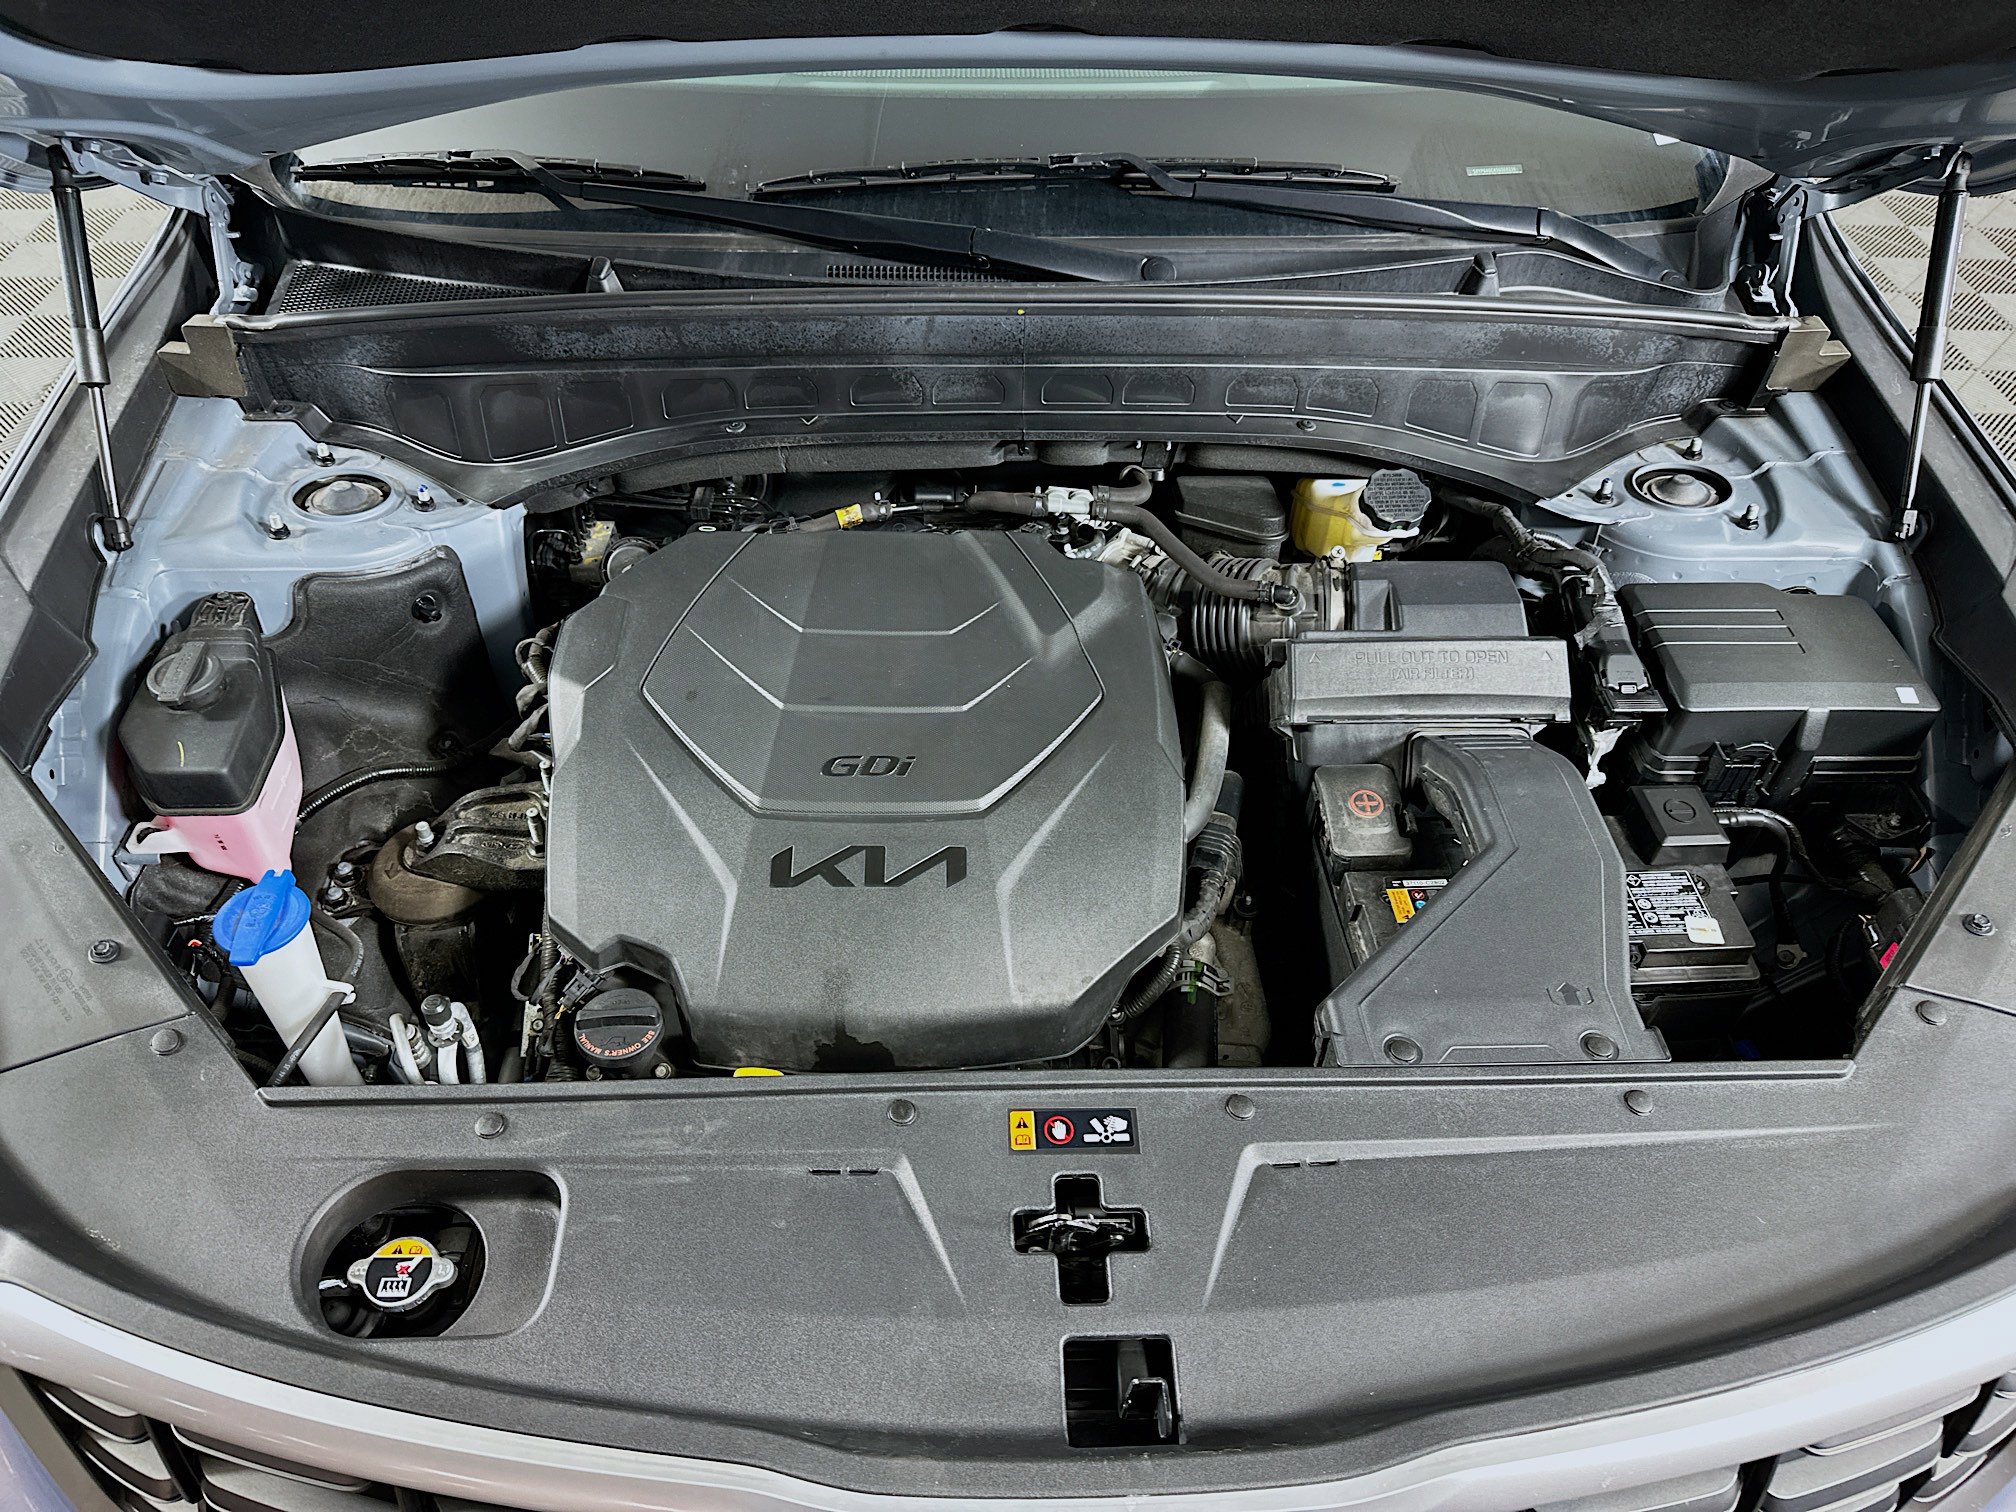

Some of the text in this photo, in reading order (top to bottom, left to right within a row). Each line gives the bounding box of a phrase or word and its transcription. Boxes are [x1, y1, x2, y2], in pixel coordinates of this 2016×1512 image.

[1355, 650, 1509, 665] PULL OUT TO OPEN
[820, 755, 916, 777] GDi
[770, 845, 967, 888] KIA
[578, 1030, 655, 1056] SEE OWNER'S MANUAL
